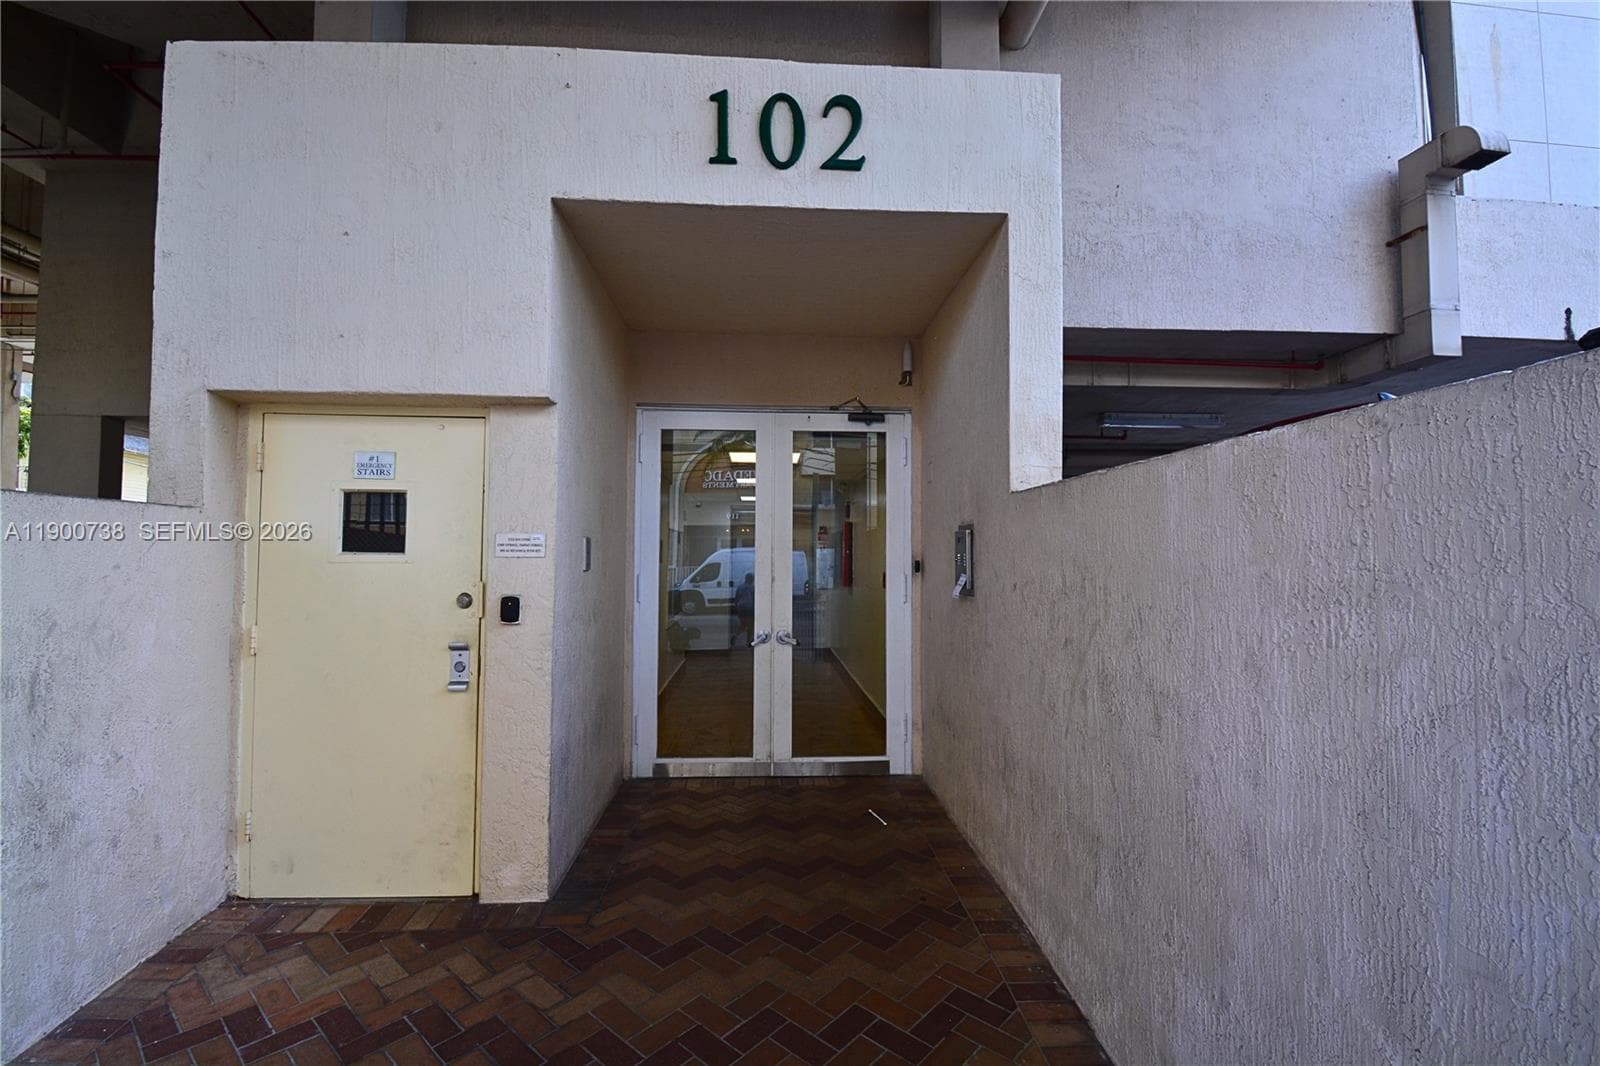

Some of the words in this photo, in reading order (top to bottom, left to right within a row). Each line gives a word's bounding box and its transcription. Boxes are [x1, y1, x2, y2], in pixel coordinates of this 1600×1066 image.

[708, 89, 866, 171] 102
[368, 455, 380, 463] #1
[356, 468, 392, 476] STAIRS
